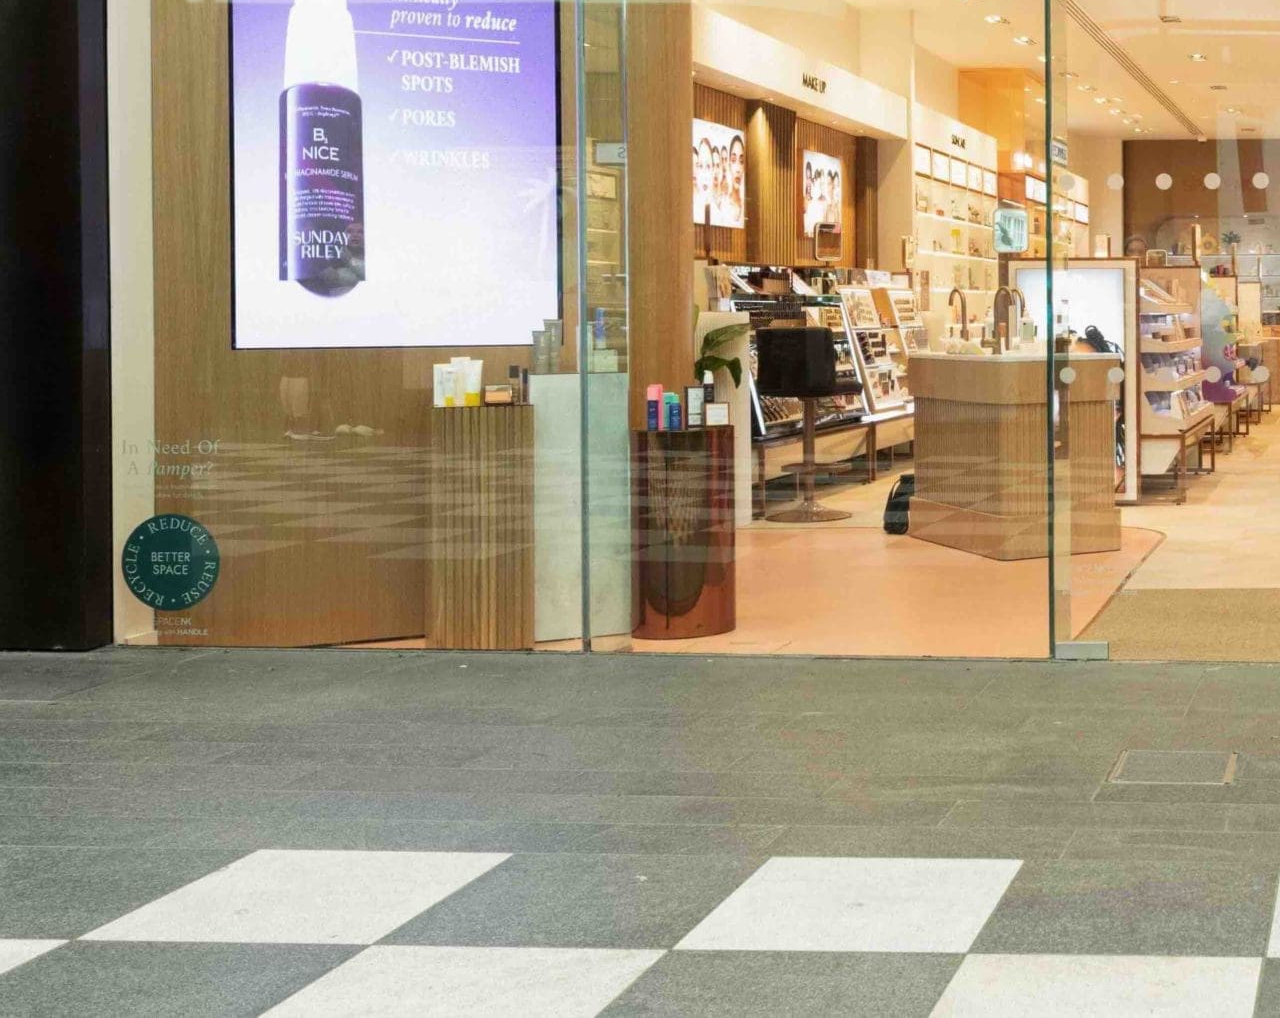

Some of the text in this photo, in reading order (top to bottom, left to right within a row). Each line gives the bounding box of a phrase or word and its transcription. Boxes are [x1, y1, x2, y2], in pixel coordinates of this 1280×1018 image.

[390, 7, 517, 32] proven to reduce
[401, 50, 521, 74] POST-BLEMISH
[402, 75, 454, 94] SPOTS
[402, 108, 457, 128] PORES
[302, 146, 340, 161] NICE
[404, 150, 490, 170] WRINKLES
[294, 230, 351, 247] SUNDAY
[301, 245, 344, 259] RILEY
[121, 439, 220, 455] In Need Of
[128, 460, 214, 480] A Pamper?
[147, 517, 208, 545] REDUCE
[151, 551, 191, 562] BETTER
[125, 543, 165, 606] RECYCLE
[153, 565, 189, 575] SPACE
[181, 561, 217, 605] REUSE
[177, 628, 209, 636] HANDLE
